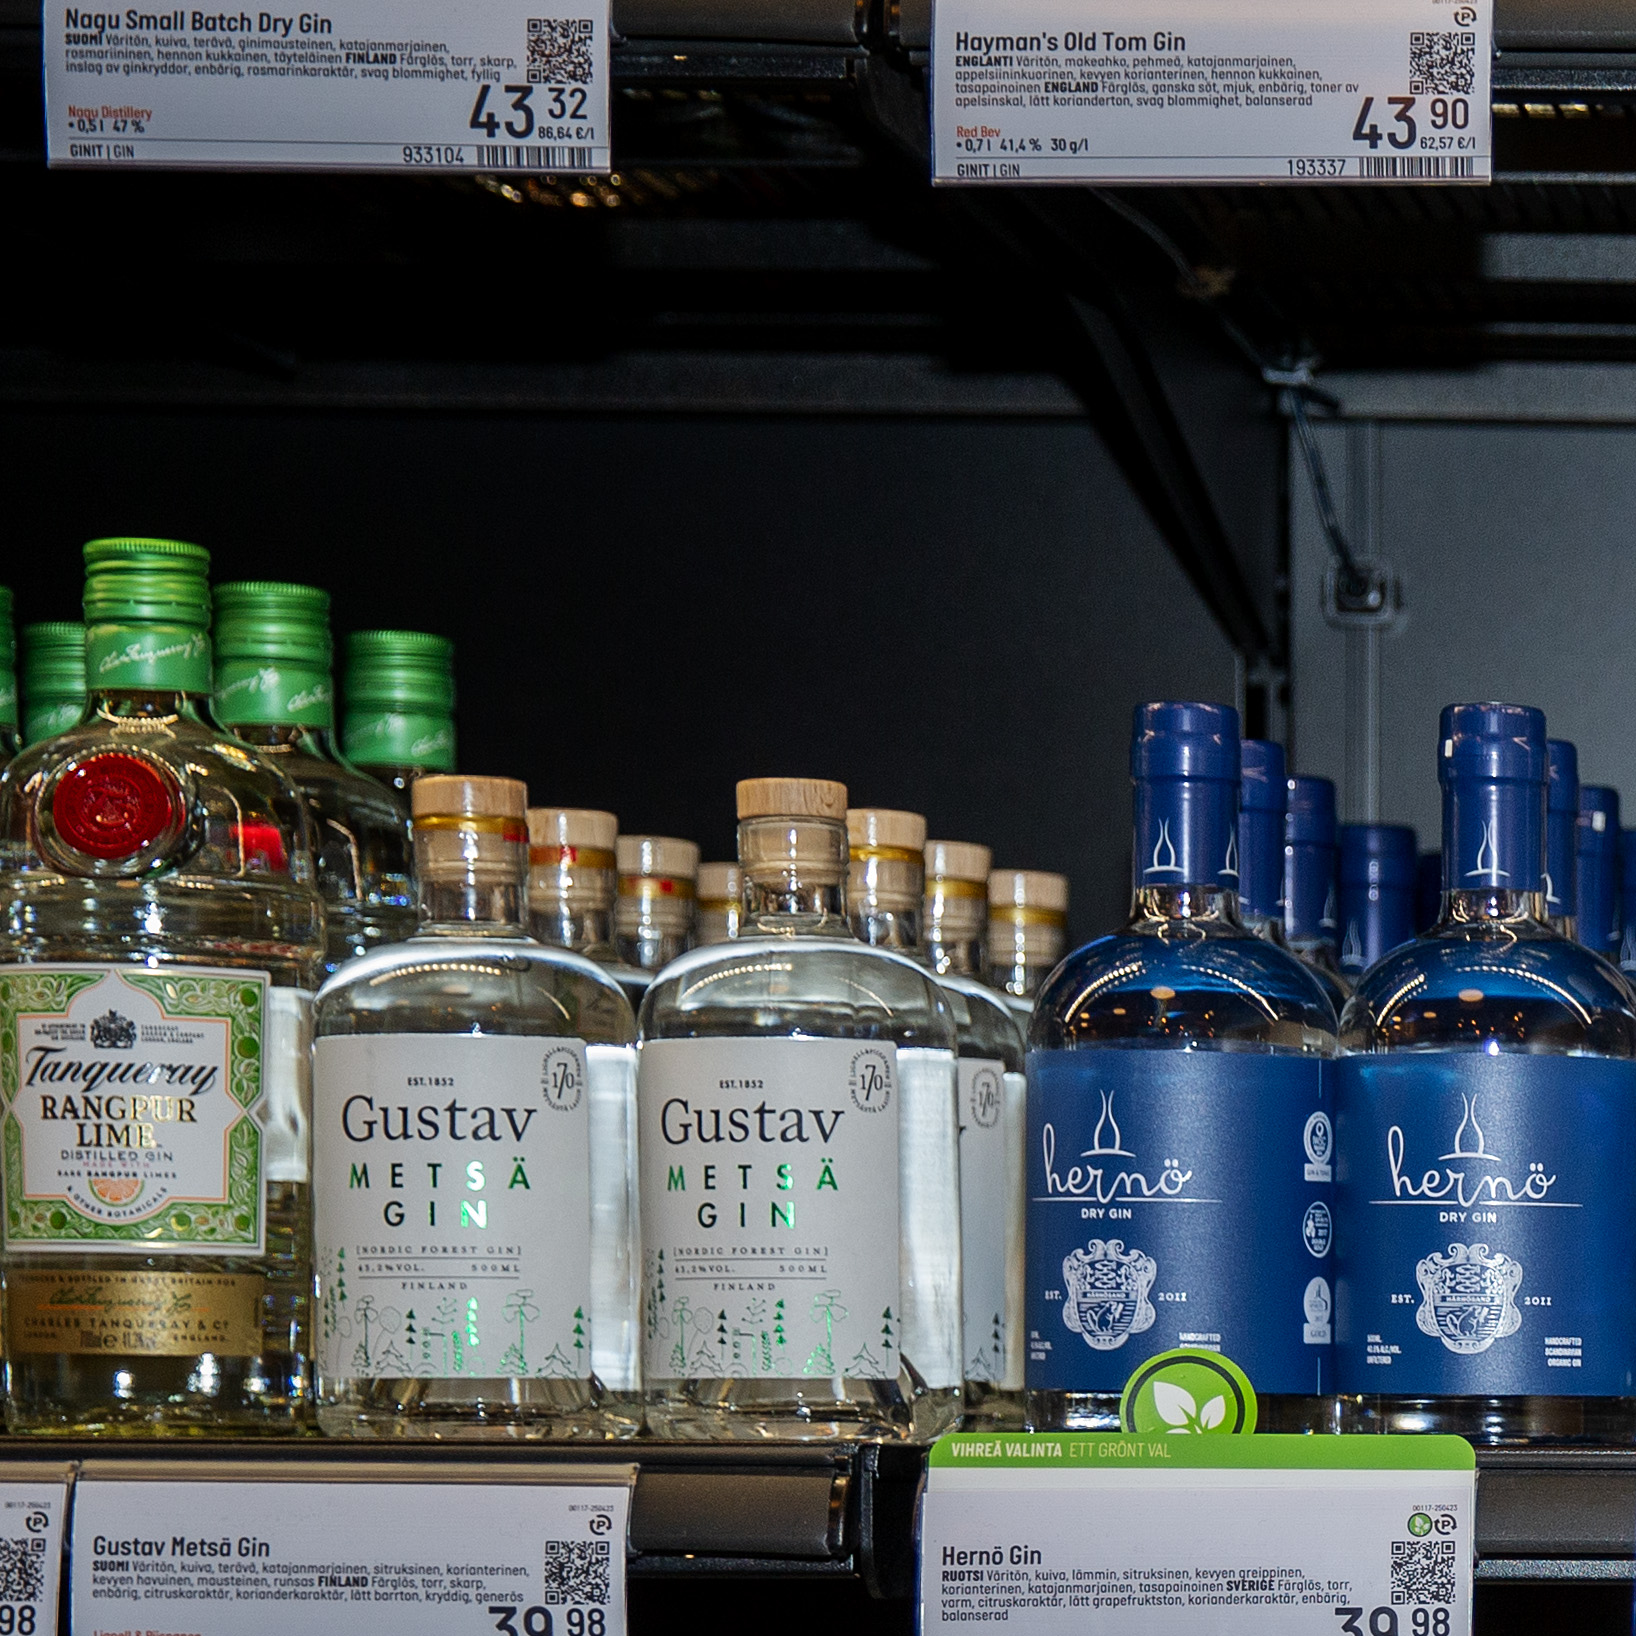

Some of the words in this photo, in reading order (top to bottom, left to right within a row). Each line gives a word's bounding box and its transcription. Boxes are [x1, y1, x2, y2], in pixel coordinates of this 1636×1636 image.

[65, 8, 120, 36] Nagu
[126, 9, 185, 31] Small
[192, 11, 252, 32] Batch
[259, 12, 293, 36] Dry
[299, 13, 332, 34] Gin
[956, 32, 1058, 54] Hayman's
[1064, 32, 1096, 51] Old
[1102, 32, 1146, 51] Tom
[1154, 31, 1185, 51] Gin
[470, 84, 534, 139] 43
[548, 87, 588, 120] 32
[1352, 97, 1417, 150] 43
[1430, 98, 1469, 130] 90
[1288, 159, 1346, 175] 193337
[25, 1045, 220, 1096] Tanqueray
[41, 1096, 197, 1123] RANGPUR
[342, 1095, 538, 1143] Gustav
[77, 1123, 156, 1148] LIME
[349, 1156, 531, 1191] METSÄ
[1387, 1124, 1557, 1208] hernö
[384, 1200, 488, 1229] GIN
[1439, 1210, 1467, 1223] DRY
[1471, 1210, 1497, 1223] GIN
[952, 1440, 1003, 1457] VIHREÄ
[1006, 1442, 1062, 1457] VALINTA
[1069, 1442, 1094, 1457] ETT
[1099, 1441, 1145, 1457] GRÖNT
[1148, 1443, 1171, 1458] VAL
[94, 1536, 165, 1558] Gustav
[171, 1537, 231, 1557] Metsä
[238, 1537, 270, 1557] Gin
[942, 1546, 1003, 1566] Hernö
[1010, 1545, 1041, 1565] Gin
